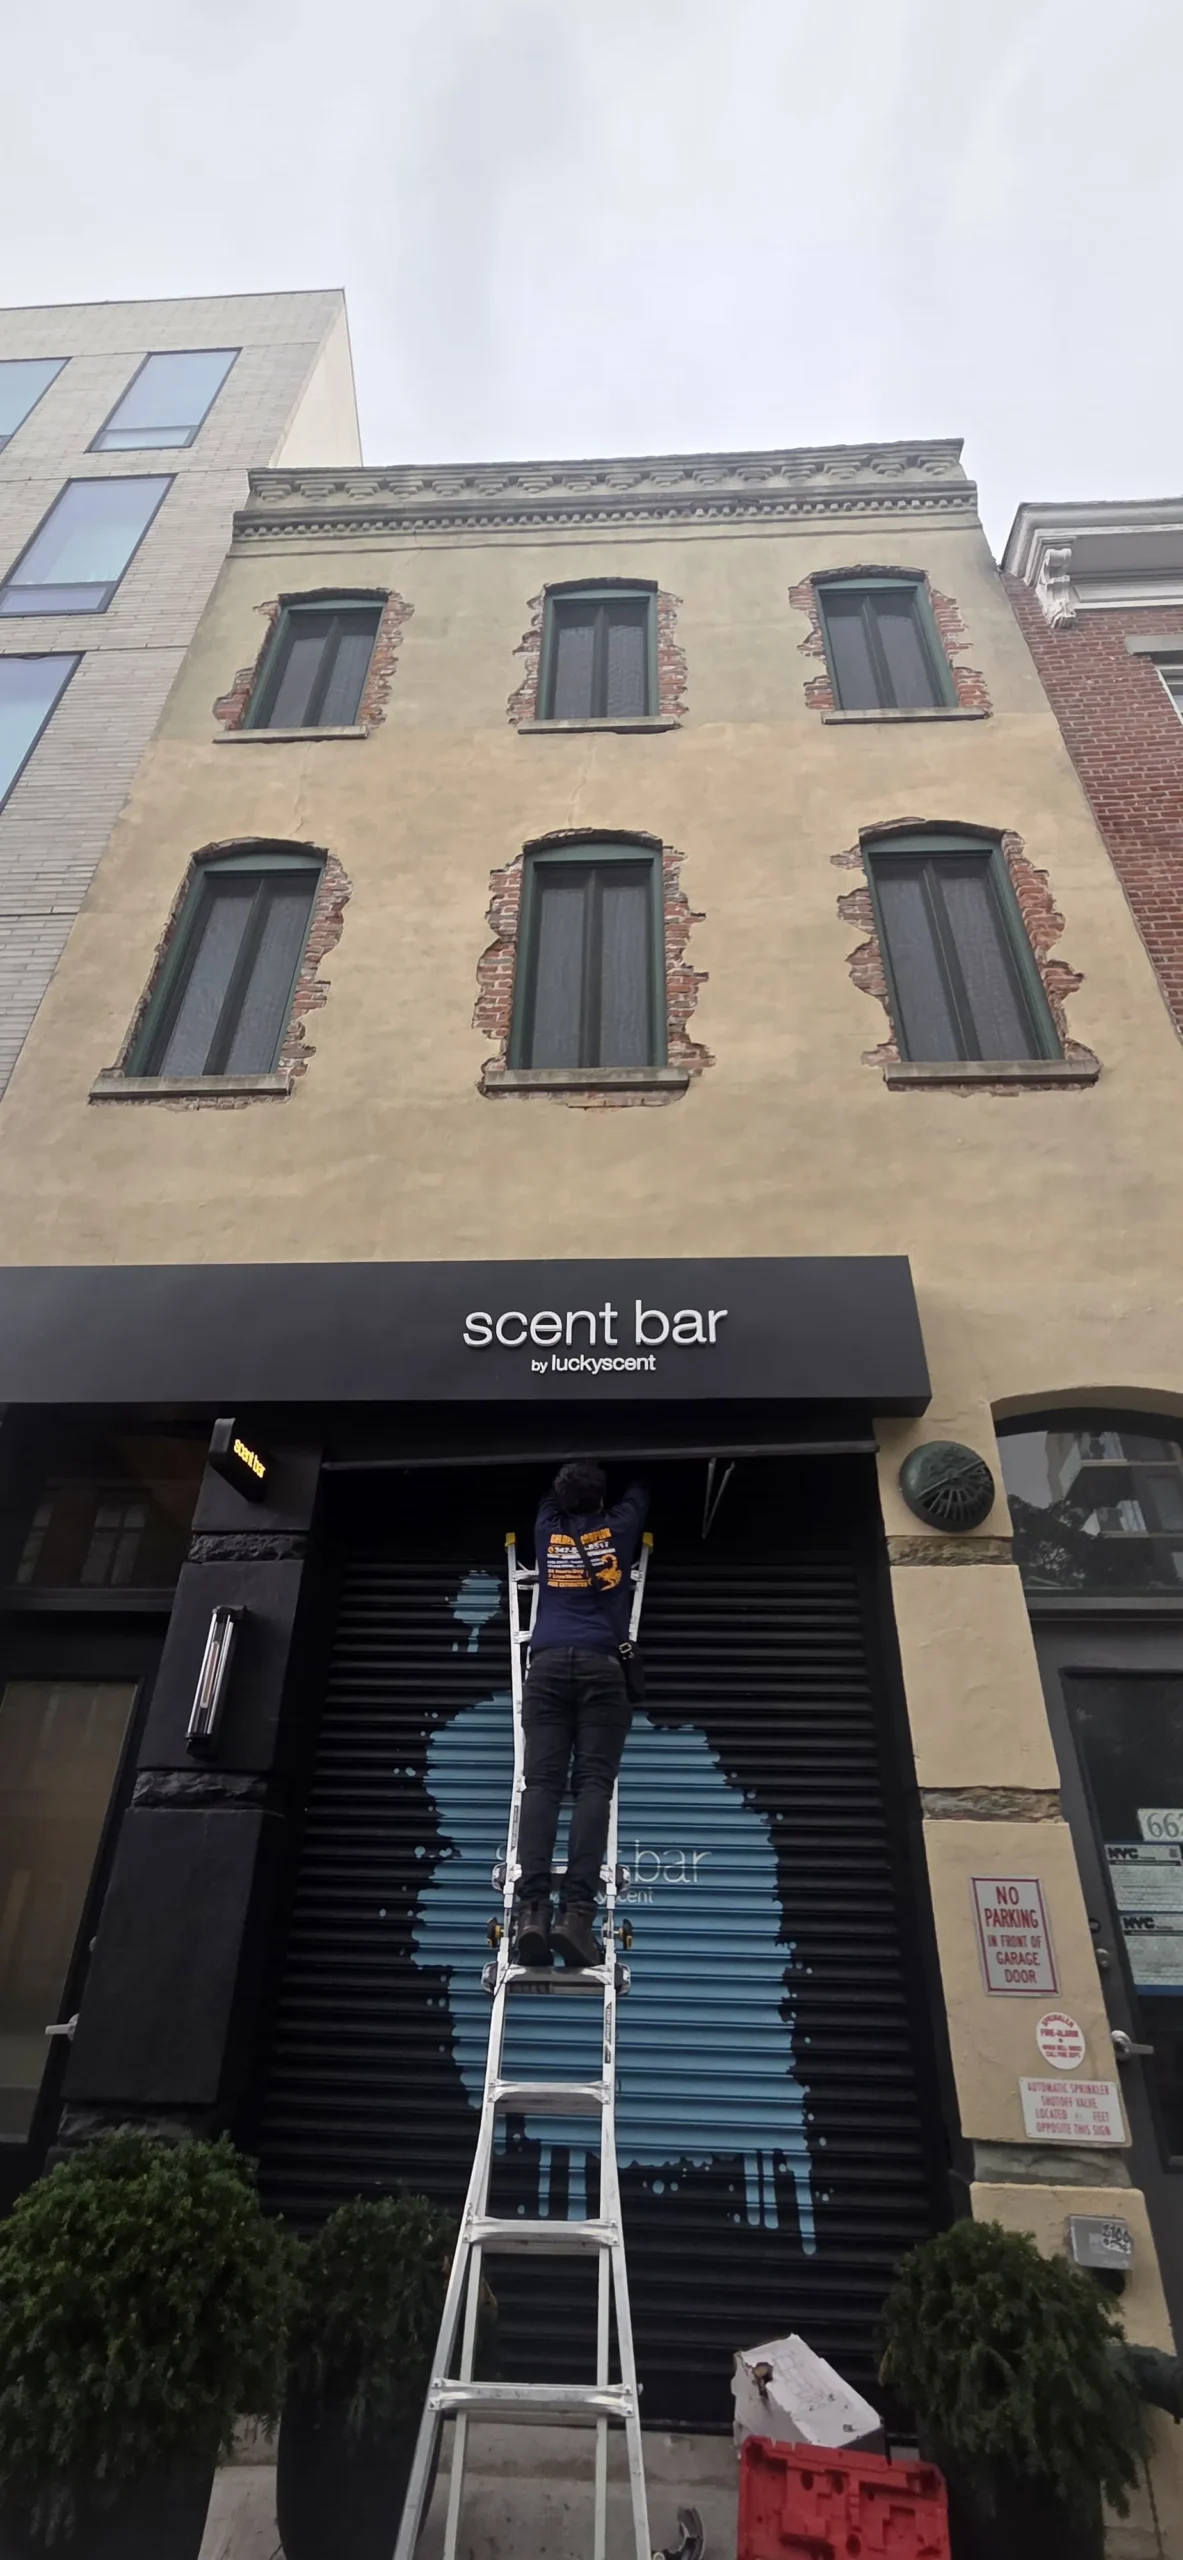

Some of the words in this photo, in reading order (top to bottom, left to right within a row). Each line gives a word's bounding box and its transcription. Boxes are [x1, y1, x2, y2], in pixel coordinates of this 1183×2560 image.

[463, 1302, 618, 1347] scent
[635, 1299, 728, 1345] bar
[531, 1359, 548, 1374] by
[551, 1354, 656, 1375] luckyscent
[234, 1439, 254, 1468] scent
[252, 1454, 266, 1478] bar
[1108, 1848, 1139, 1860] NYC
[634, 1839, 714, 1884] bar
[996, 1886, 1019, 1905] NO
[984, 1908, 1039, 1929] PARKING
[1123, 1917, 1155, 1929] NYC
[987, 1935, 998, 1947] IN
[1001, 1935, 1028, 1948] FRONT
[1031, 1935, 1042, 1948] OF
[996, 1951, 1041, 1966] GARAGE
[1004, 1969, 1038, 1983] DOOR
[1028, 2083, 1068, 2094] AUTOMATIC
[1070, 2083, 1110, 2095] SPRINKLER
[1041, 2095, 1073, 2107] SHUTOFF
[1075, 2098, 1098, 2109] VALVE
[1035, 2108, 1068, 2120] LOCATED
[1093, 2111, 1109, 2122] FEET
[1036, 2122, 1072, 2135] OPPOSITE
[1073, 2123, 1091, 2135] THIS
[1093, 2125, 1111, 2136] SIGN
